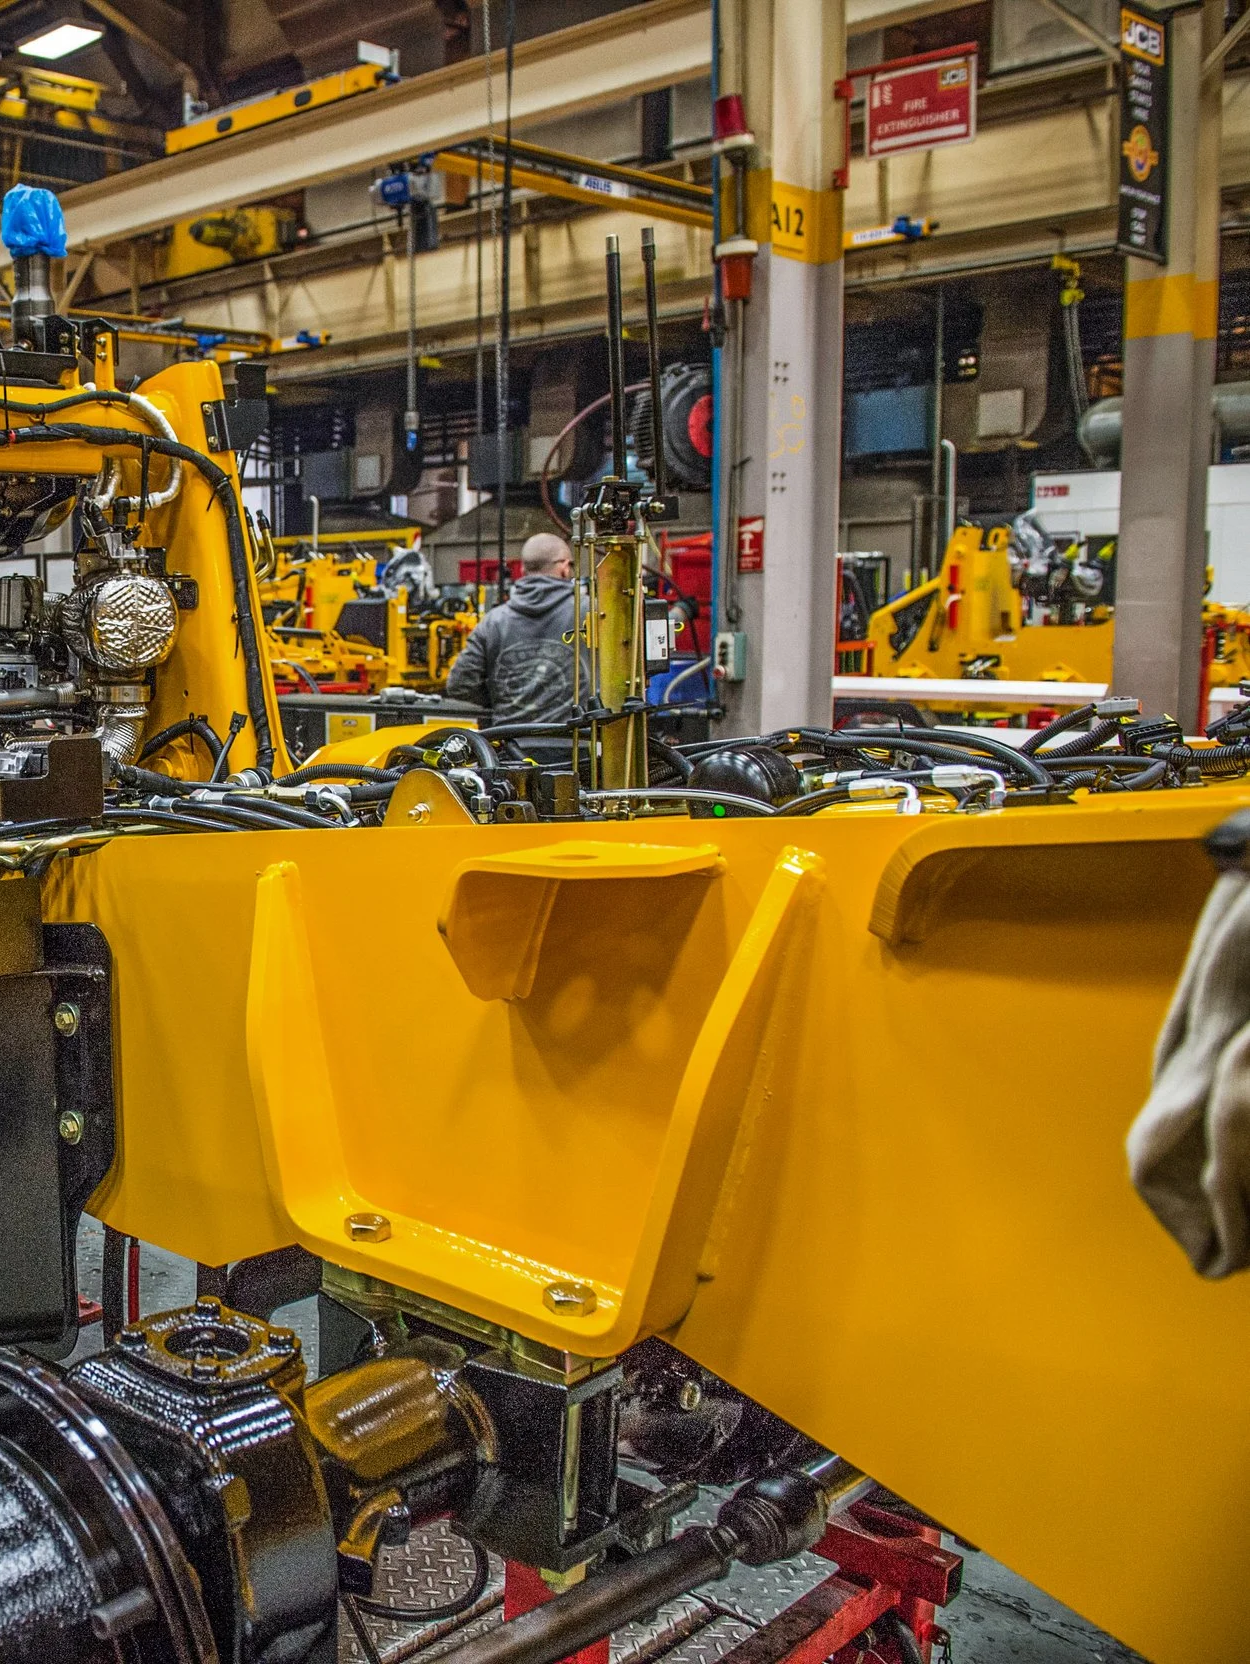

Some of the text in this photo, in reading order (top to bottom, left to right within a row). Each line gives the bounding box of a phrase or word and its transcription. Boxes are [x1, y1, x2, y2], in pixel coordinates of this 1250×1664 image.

[1126, 21, 1160, 56] JCB
[941, 68, 968, 86] JCB
[902, 97, 927, 113] FIRE
[877, 108, 960, 136] EXTINGUISHER
[771, 201, 805, 236] A12
